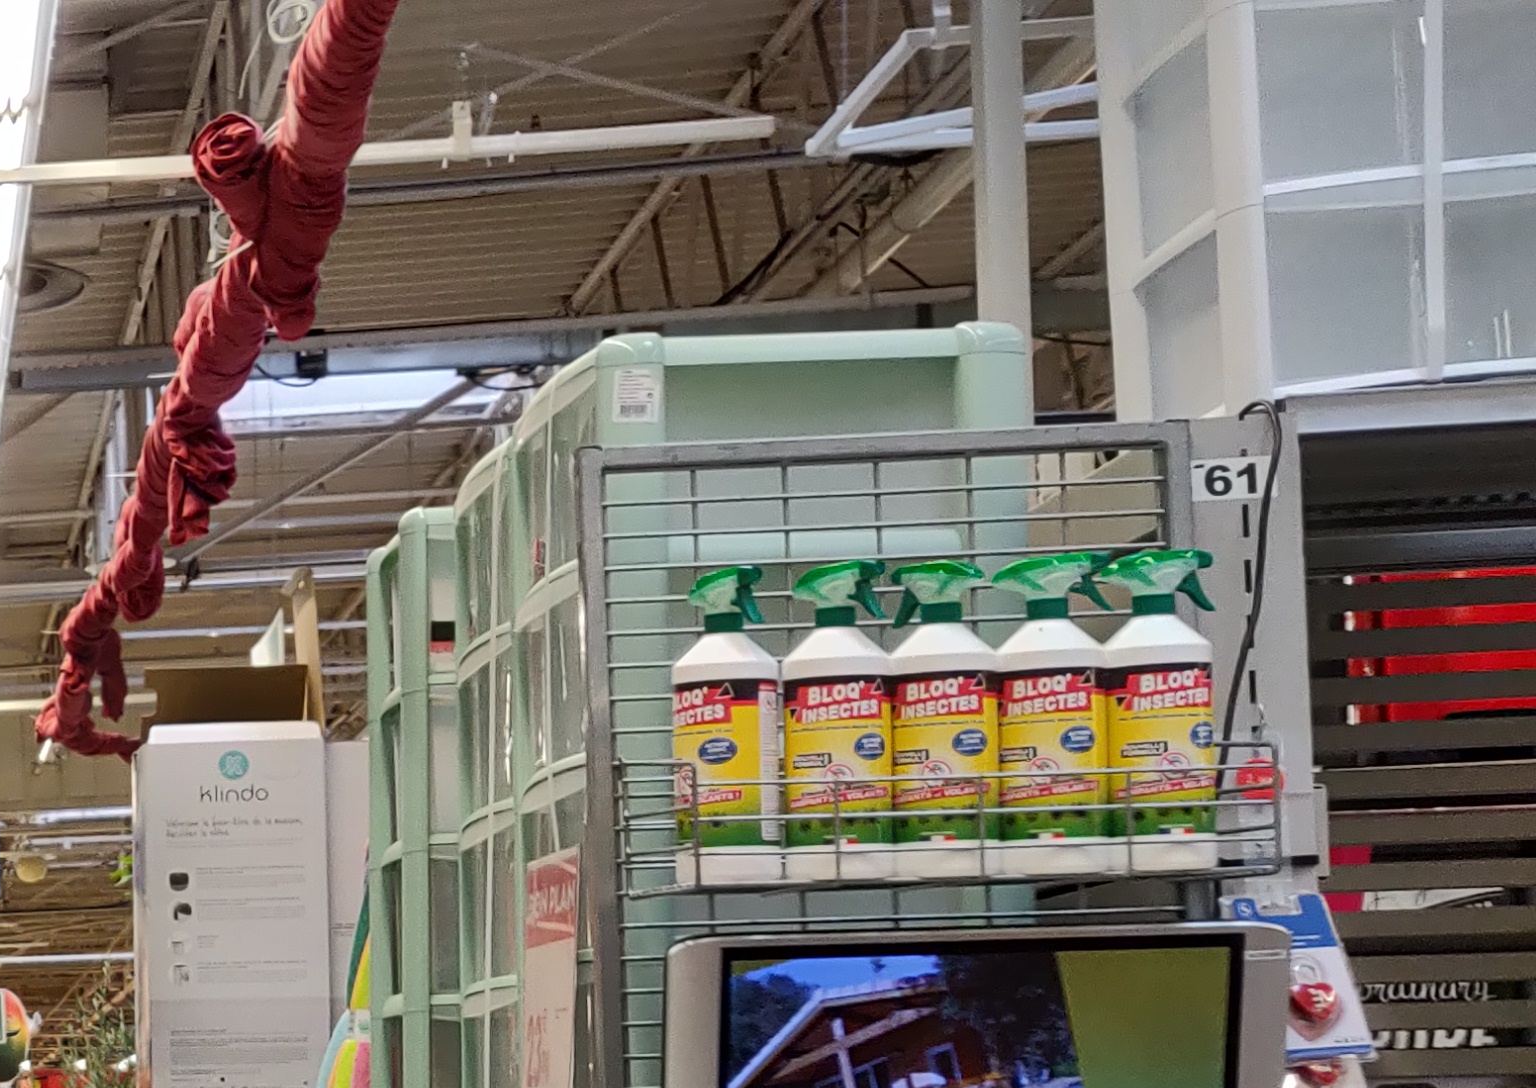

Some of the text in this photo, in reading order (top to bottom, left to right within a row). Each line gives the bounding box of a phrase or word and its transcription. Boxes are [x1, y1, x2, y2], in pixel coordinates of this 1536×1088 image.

[1204, 463, 1259, 496] 61
[808, 680, 866, 705] BLOQ'
[906, 676, 964, 701] BLOQ'
[1012, 673, 1072, 698] BLOQ'
[1139, 668, 1199, 694] BLOQ'
[801, 699, 879, 724] INSECTES
[901, 694, 979, 720] INSECTES
[1007, 691, 1088, 717] INSECTES
[199, 783, 270, 803] klindo
